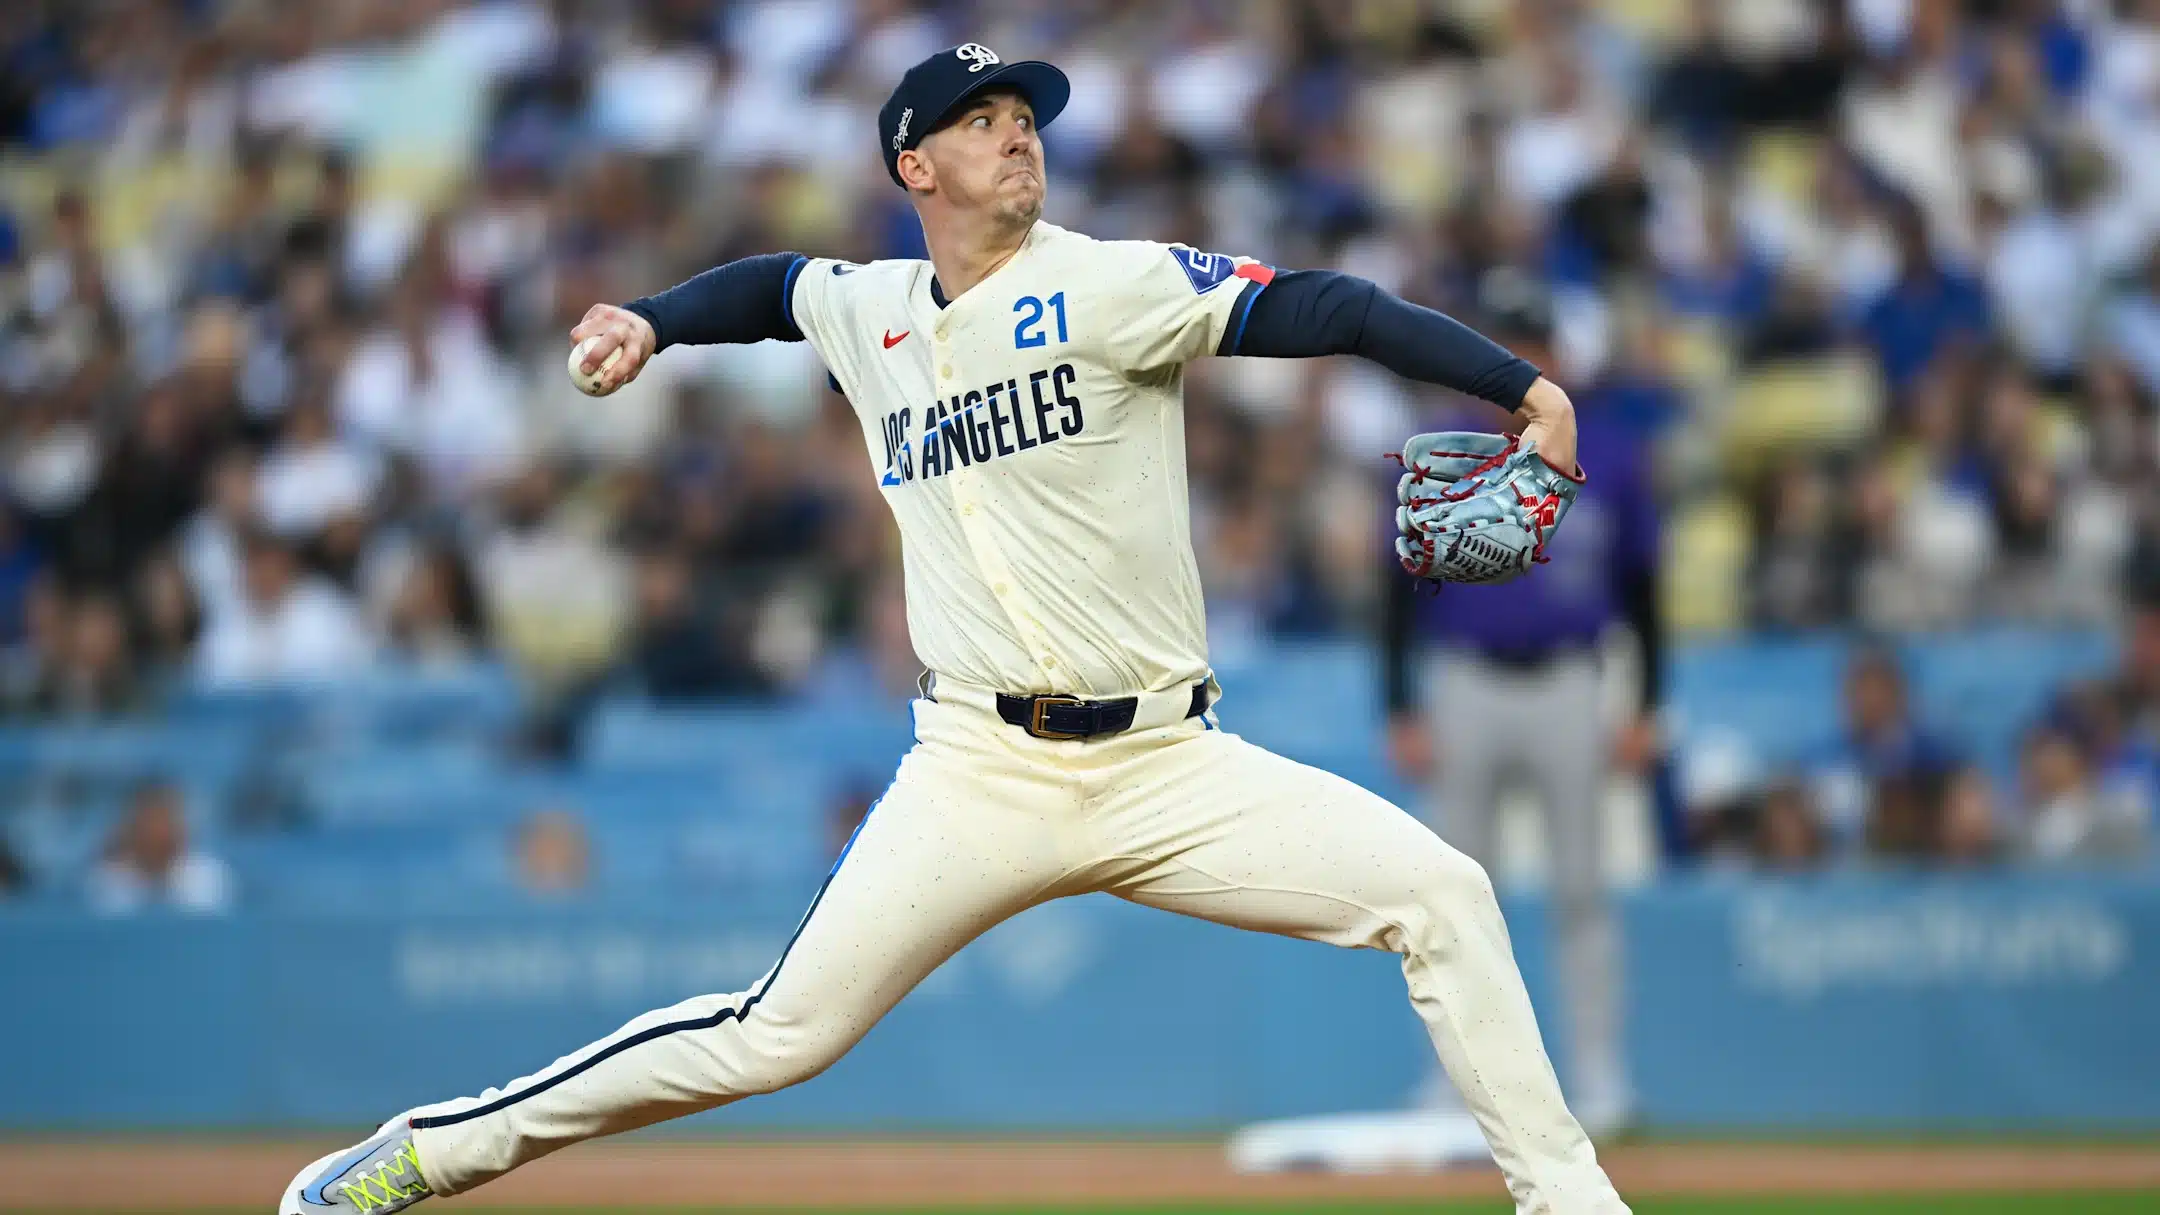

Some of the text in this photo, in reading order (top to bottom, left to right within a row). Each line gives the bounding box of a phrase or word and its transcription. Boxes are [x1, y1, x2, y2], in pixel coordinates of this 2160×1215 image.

[893, 107, 914, 152] Dodgers
[1013, 291, 1069, 349] 21
[881, 363, 1084, 487] LOS ANGELES
